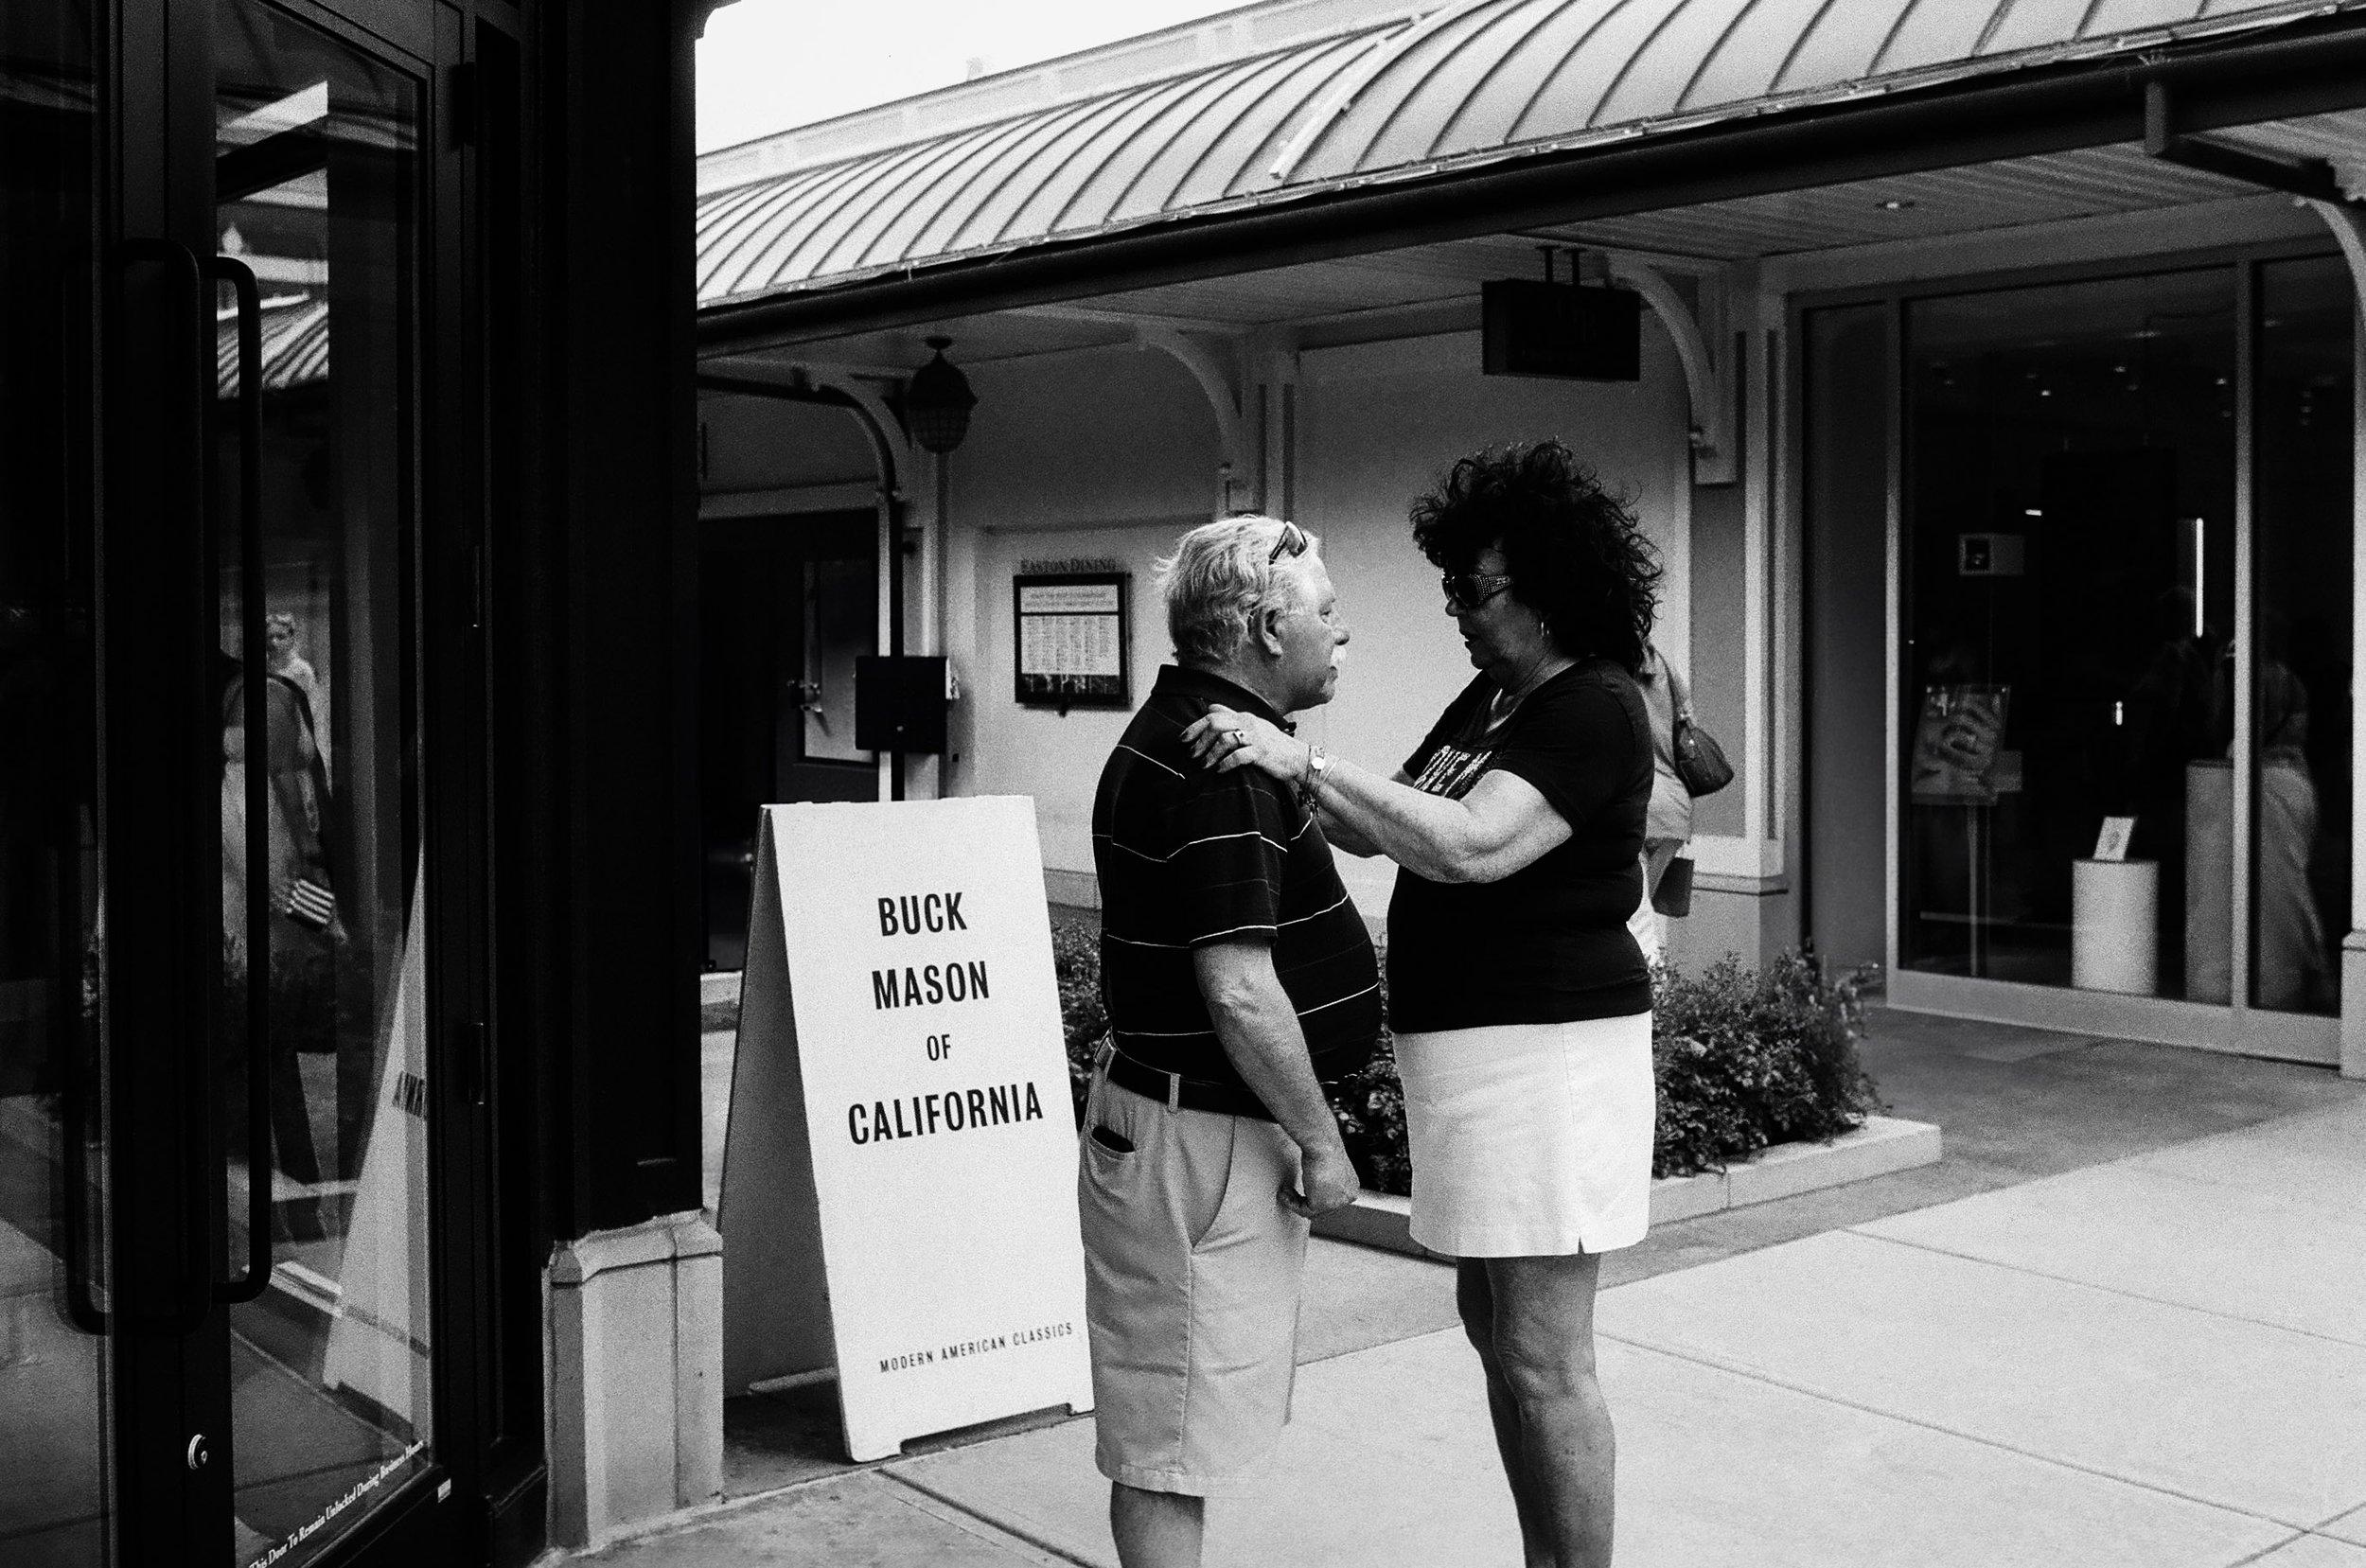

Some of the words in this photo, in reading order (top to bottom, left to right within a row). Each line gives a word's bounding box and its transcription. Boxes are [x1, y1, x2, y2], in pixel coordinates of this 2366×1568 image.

[878, 892, 967, 936] BUCK
[872, 960, 989, 1010] MASON
[927, 1034, 951, 1061] OF
[848, 1082, 1043, 1145] CALIFORNIA
[879, 1350, 934, 1373] MODERN
[941, 1335, 1007, 1361] AMERICAN
[1012, 1322, 1073, 1346] CLASSICS
[268, 1548, 288, 1565] Door
[288, 1533, 298, 1549] To
[298, 1515, 326, 1542] Remain
[326, 1486, 356, 1520] Unlocked
[357, 1473, 380, 1497] During
